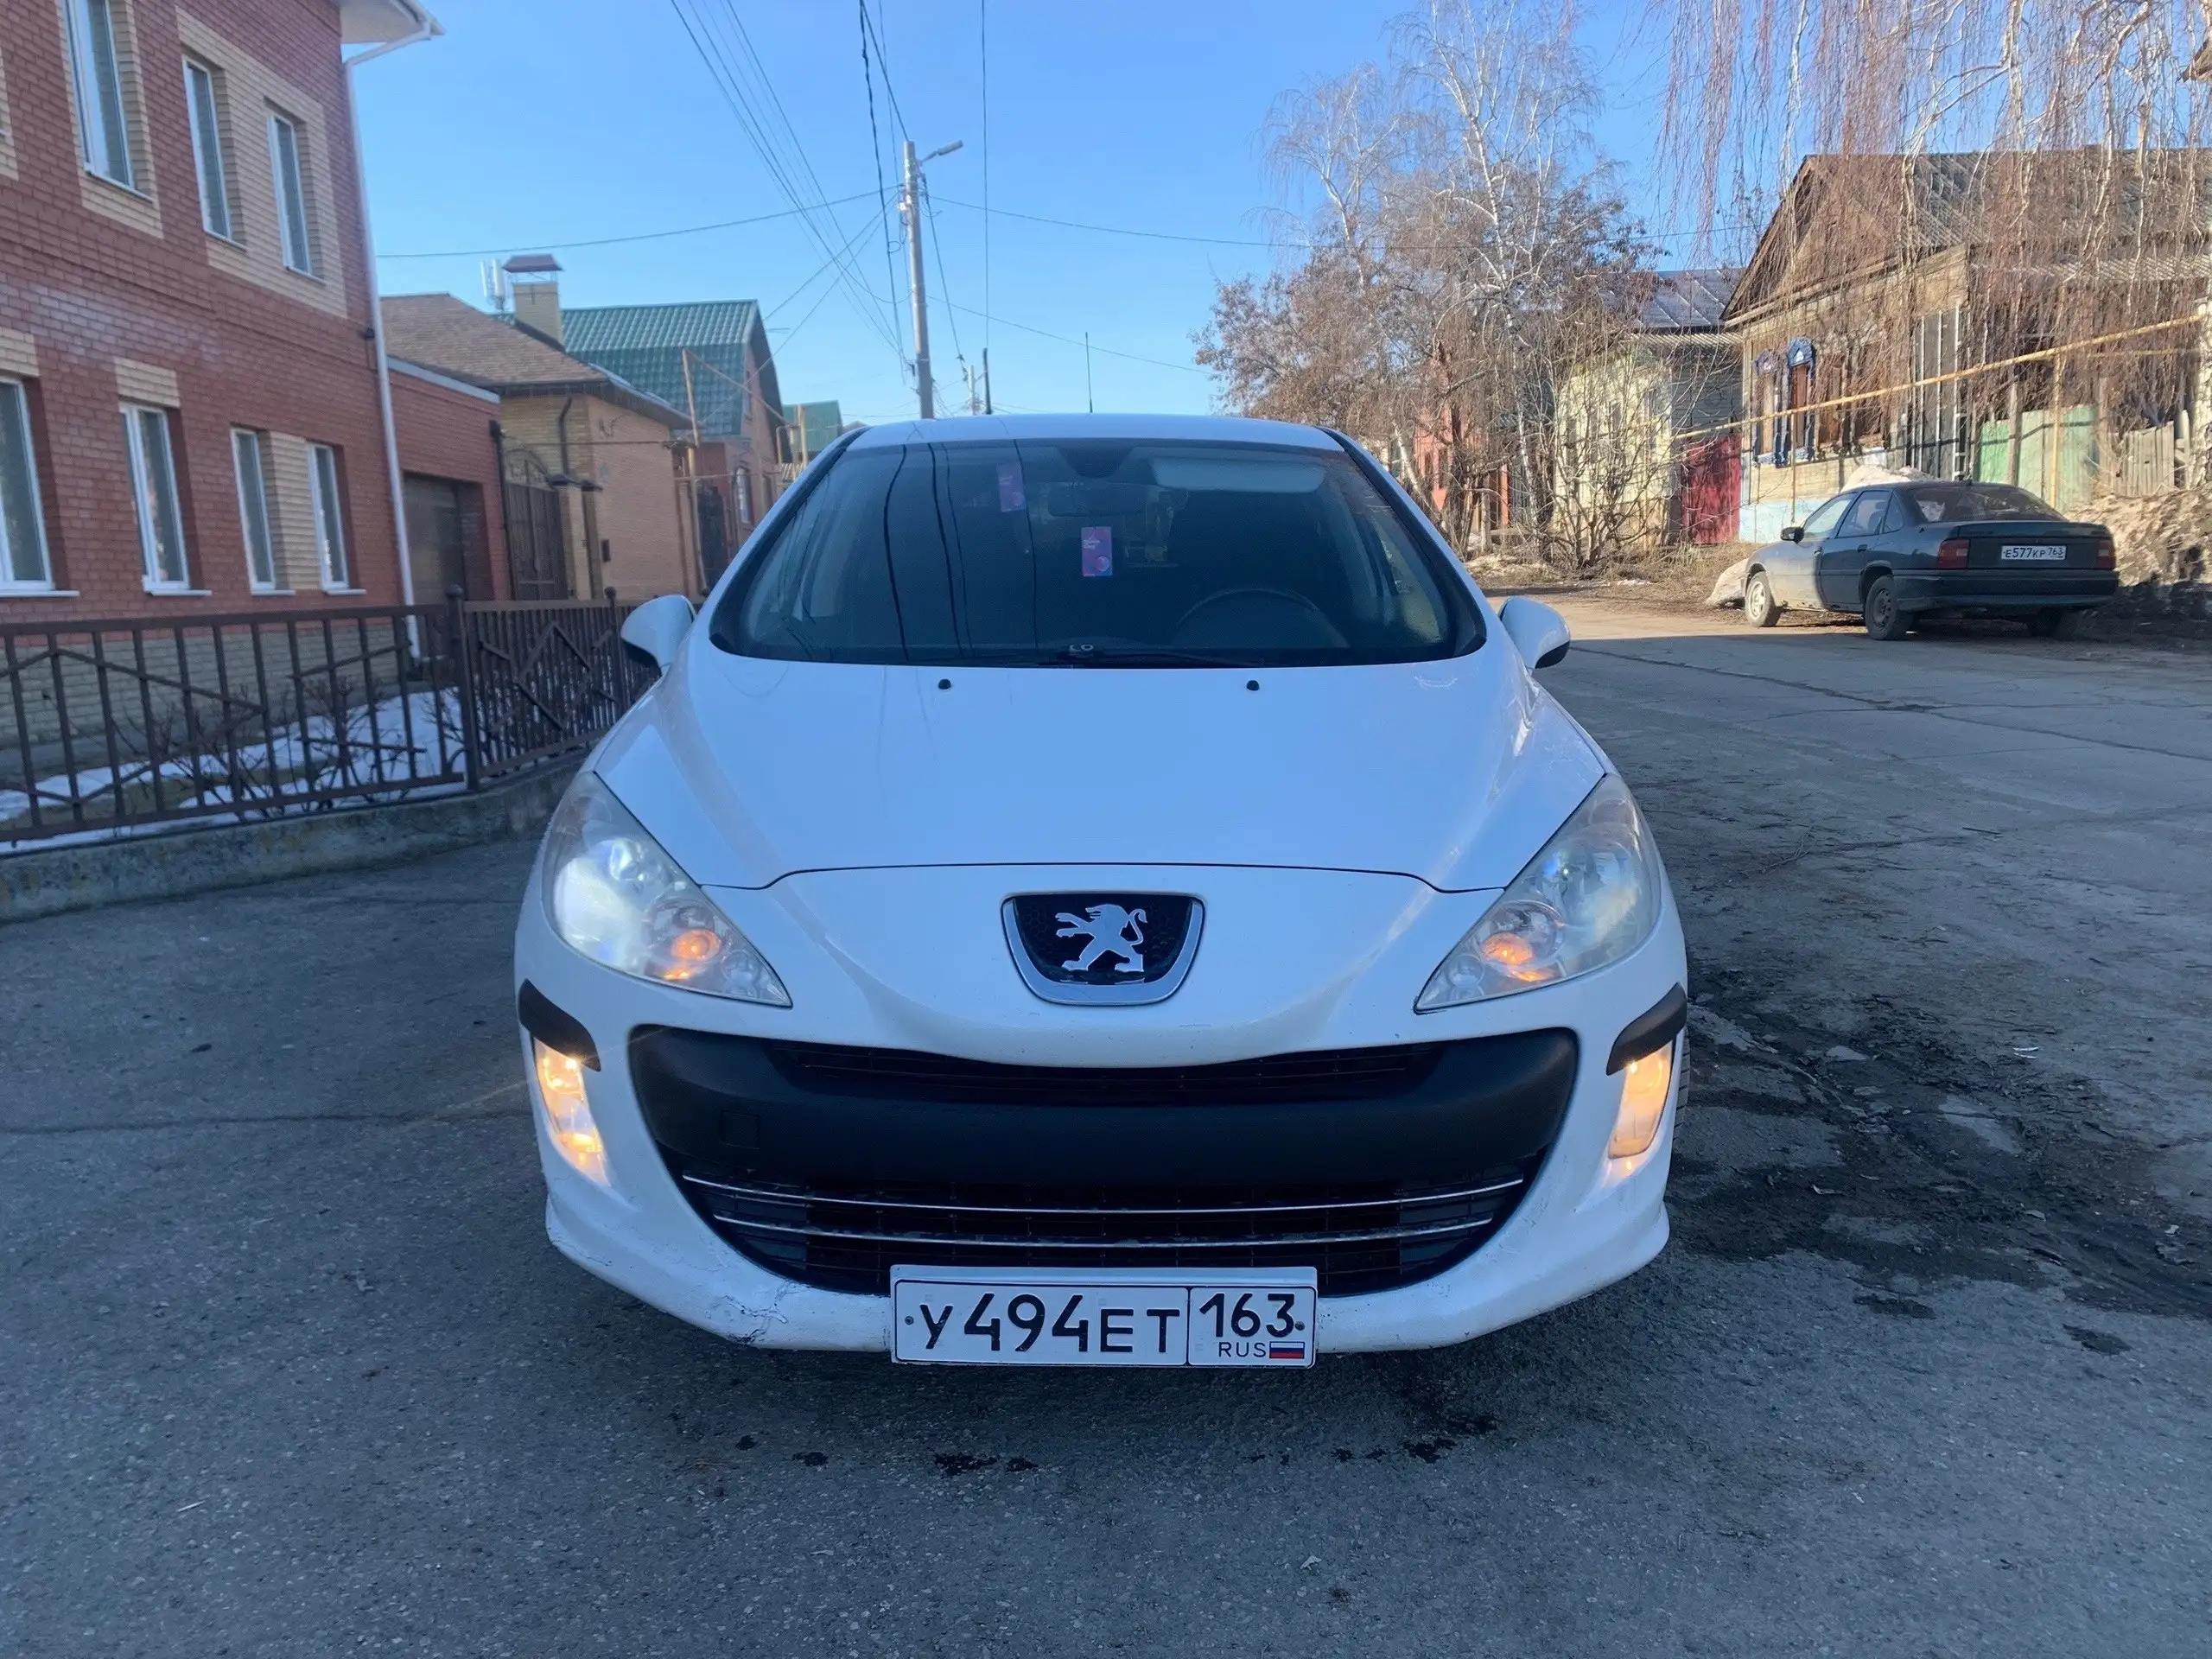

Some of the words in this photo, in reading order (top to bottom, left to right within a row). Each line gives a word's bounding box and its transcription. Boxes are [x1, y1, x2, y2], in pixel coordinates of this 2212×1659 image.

[918, 1293, 1181, 1354] У494ЕТ
[1198, 1293, 1296, 1338] 163
[1218, 1341, 1267, 1358] RUS
